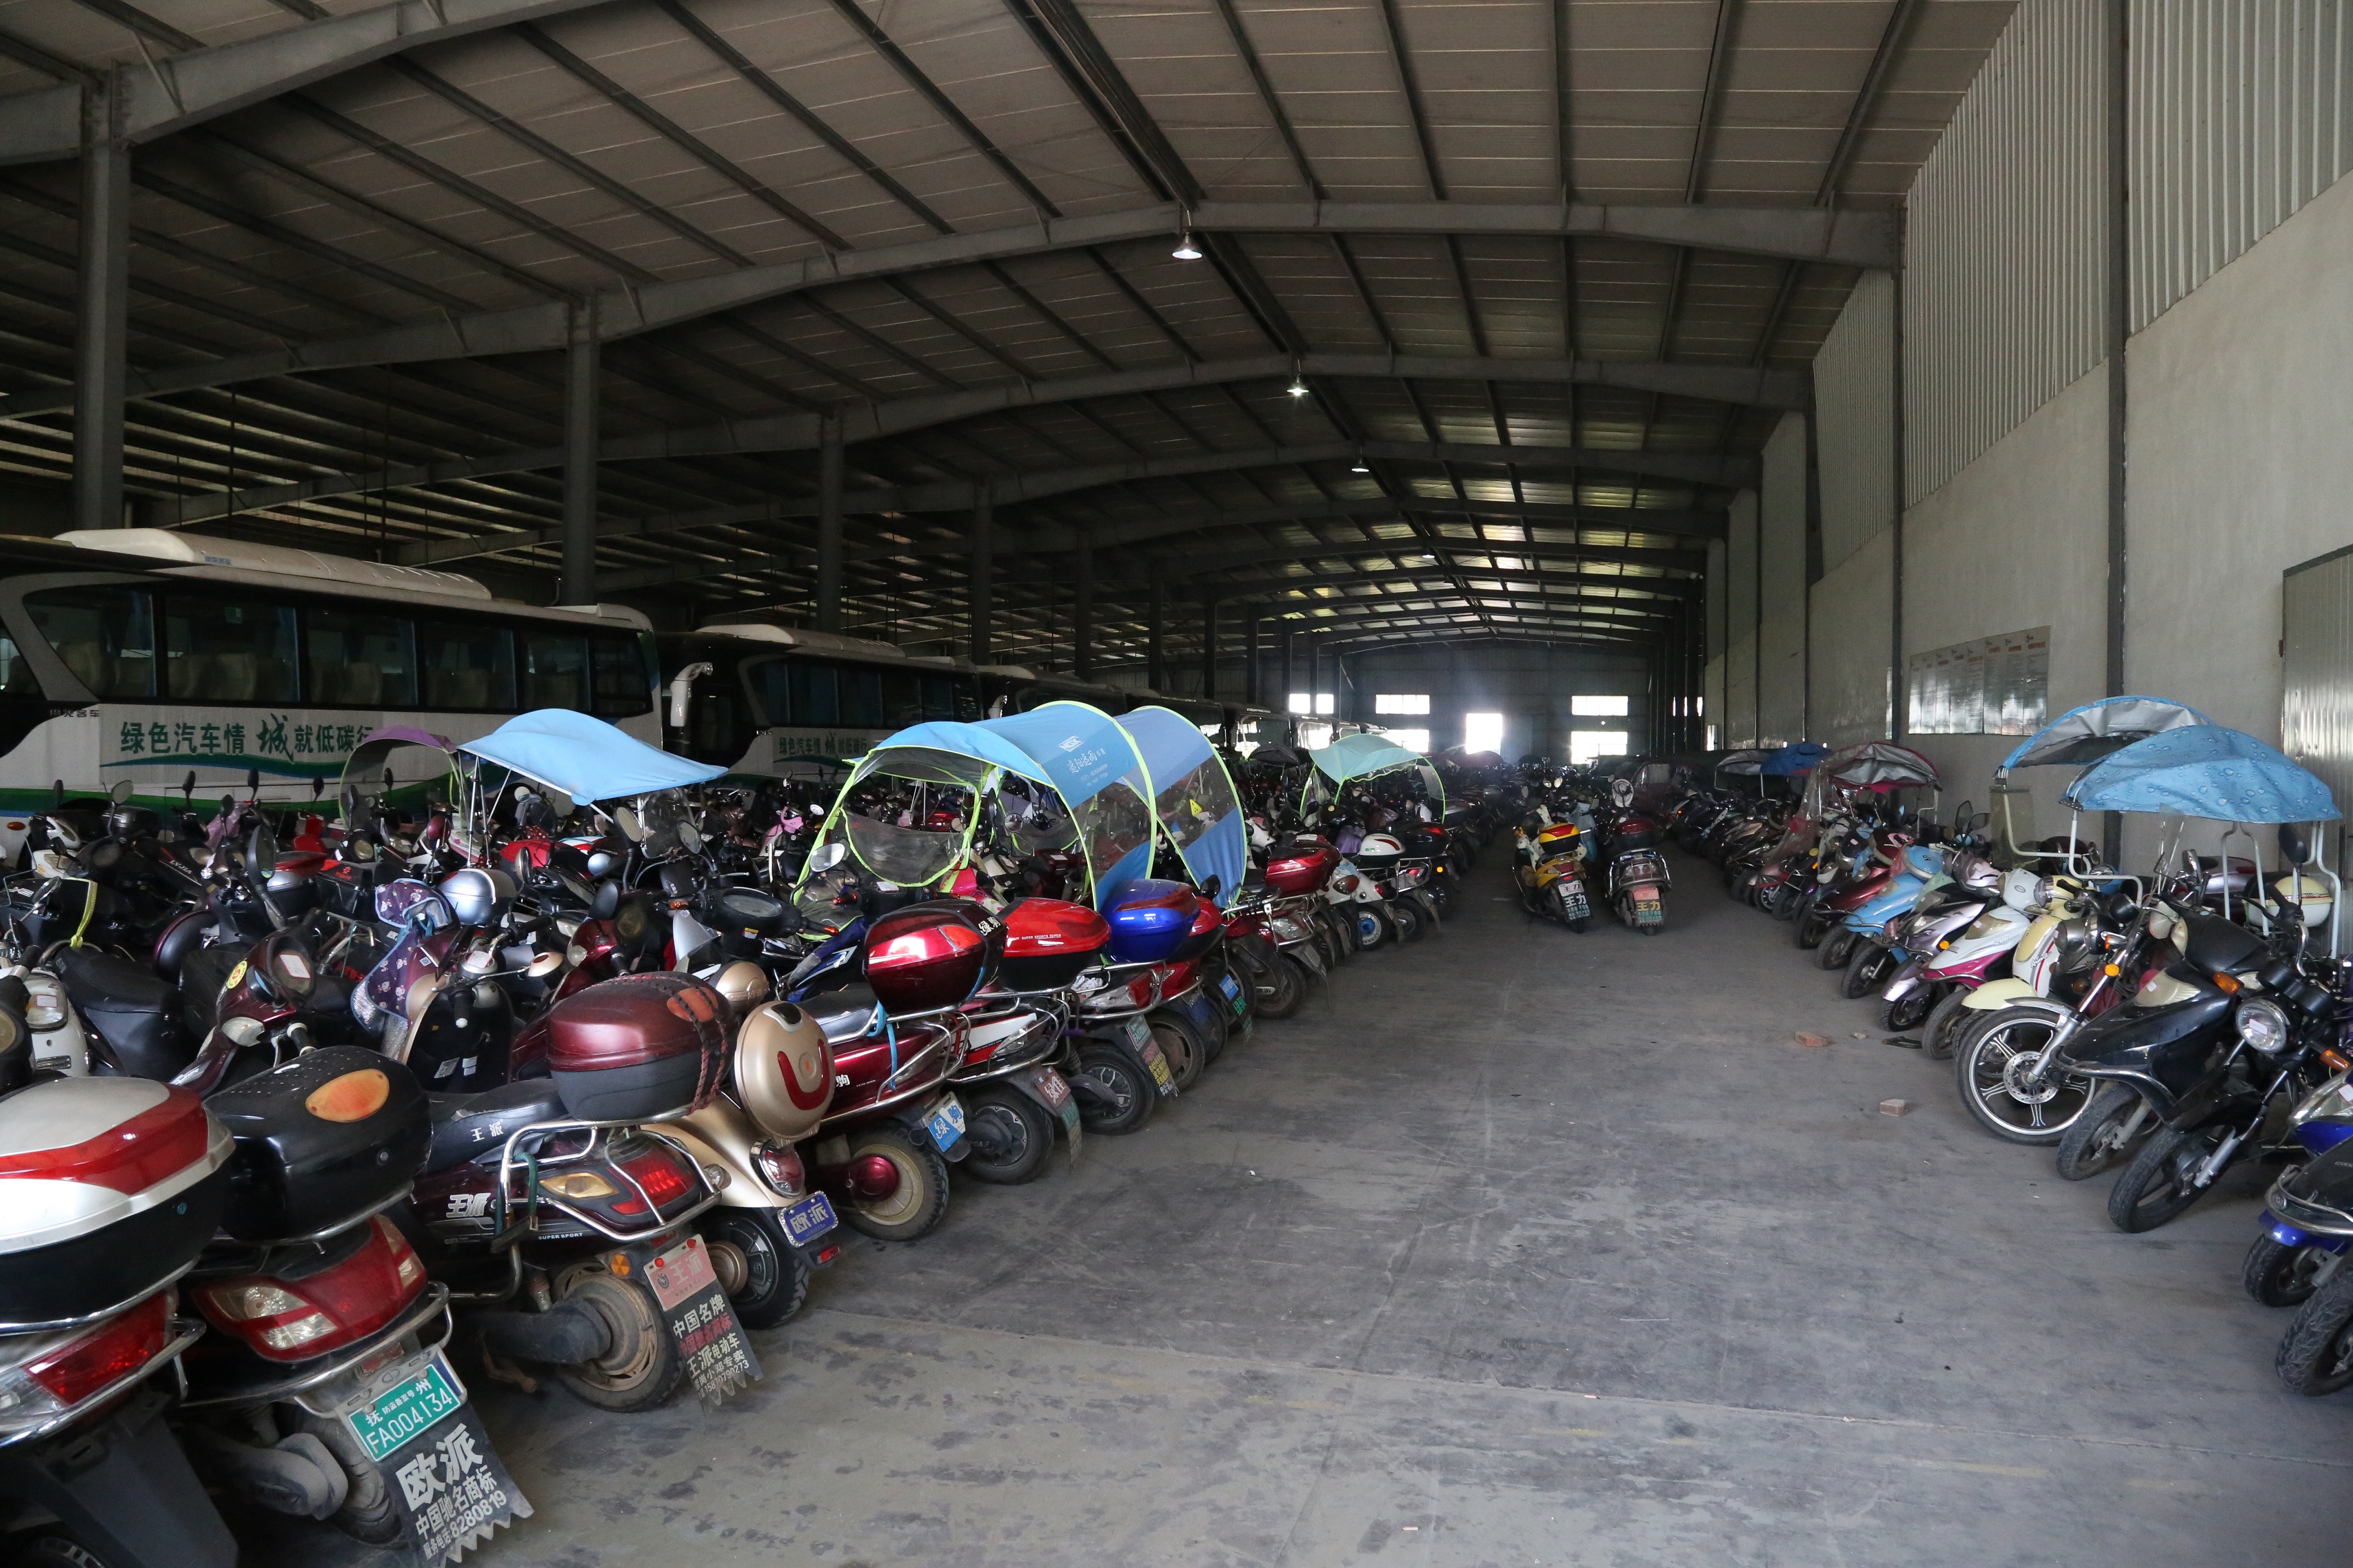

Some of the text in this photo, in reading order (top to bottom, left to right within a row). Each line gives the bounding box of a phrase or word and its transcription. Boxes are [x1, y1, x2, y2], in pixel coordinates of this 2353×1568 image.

[1564, 894, 1587, 908] 王力
[1637, 900, 1661, 911] 王力
[471, 1121, 504, 1142] 王派
[934, 1105, 962, 1139] 绿驹
[446, 1192, 491, 1218] 王派
[790, 1202, 829, 1234] 欧派
[669, 1251, 703, 1285] 王派
[673, 1294, 725, 1339] 中国名牌
[687, 1332, 740, 1379] 王派电动车
[366, 1378, 432, 1426] 抚 防盗备案号 州
[366, 1387, 452, 1453] FA004134
[396, 1423, 483, 1512] 欧派
[416, 1465, 497, 1539] 中国驰名商标
